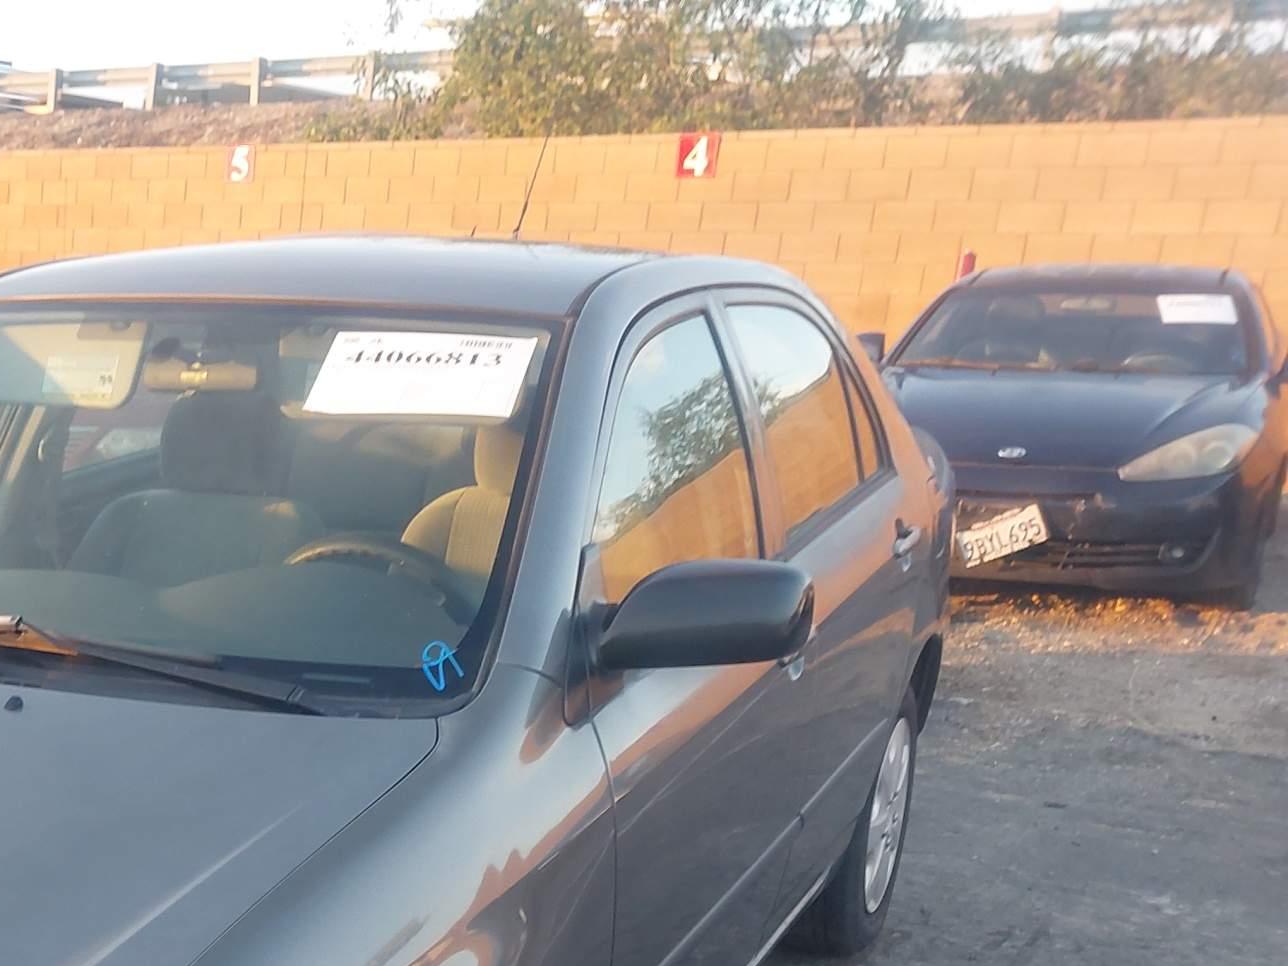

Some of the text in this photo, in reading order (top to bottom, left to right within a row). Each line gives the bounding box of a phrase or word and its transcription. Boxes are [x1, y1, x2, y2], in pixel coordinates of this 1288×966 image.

[231, 145, 249, 181] 5
[682, 135, 709, 177] 4
[345, 350, 503, 366] 44066813
[963, 516, 1041, 560] 9BYL695
